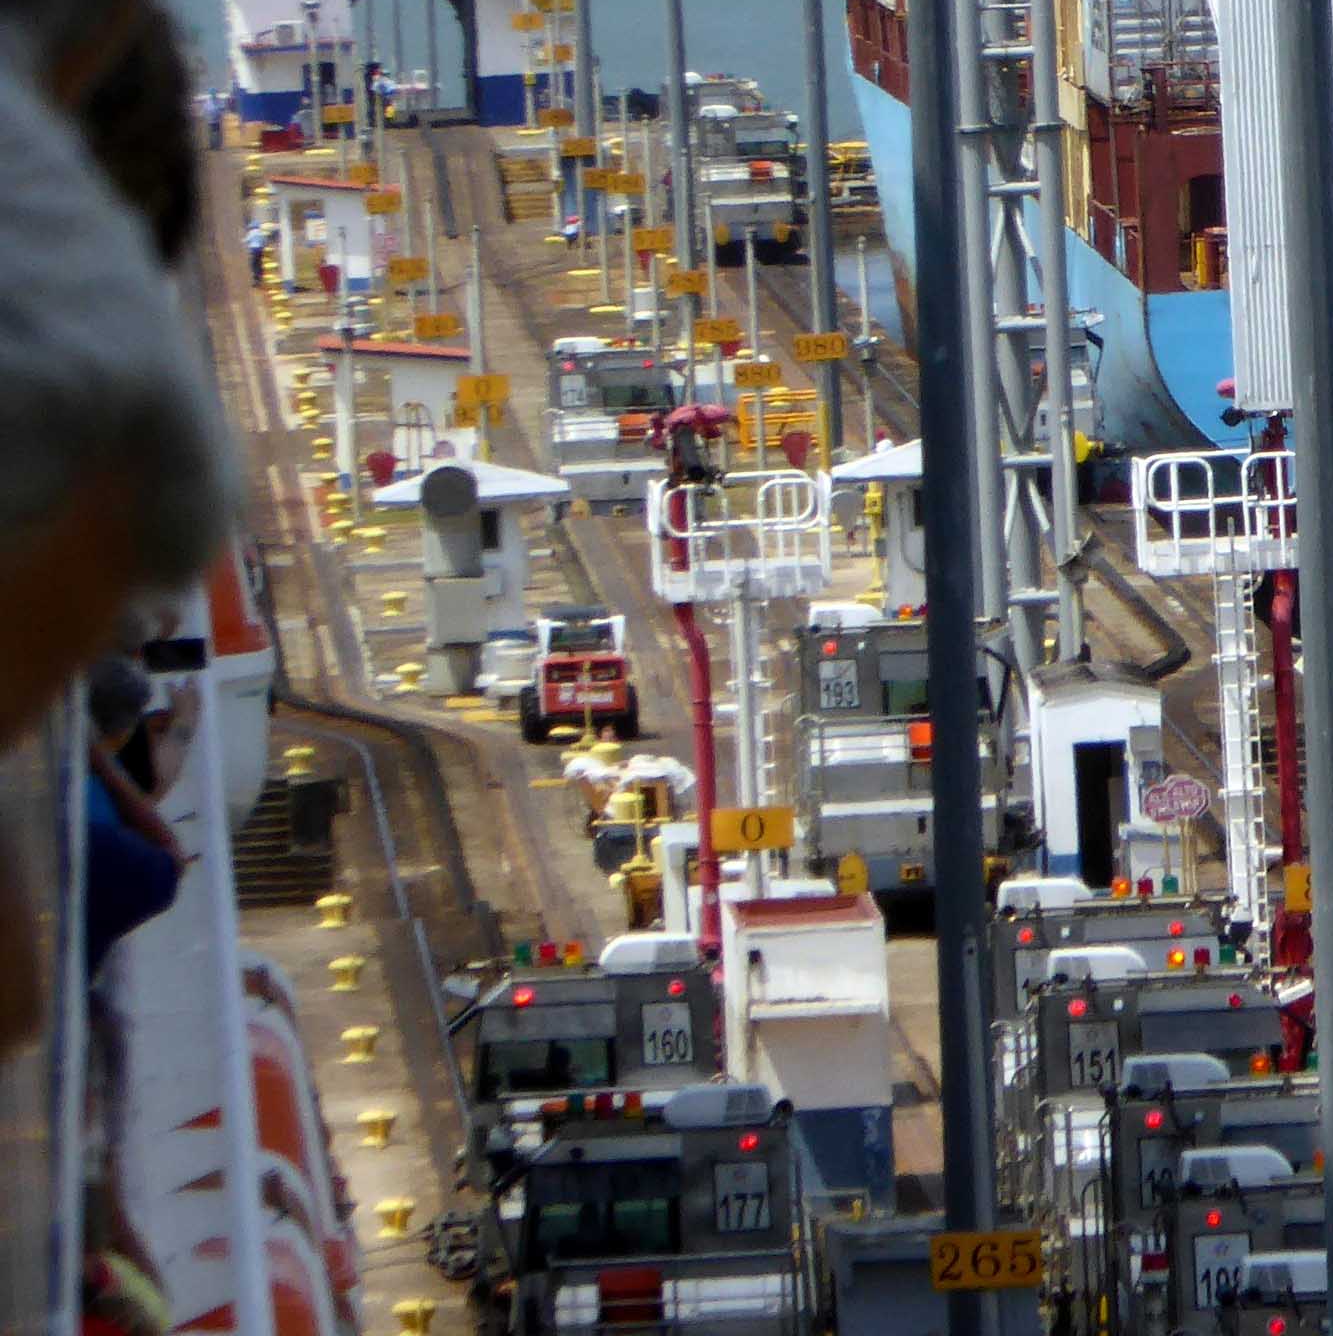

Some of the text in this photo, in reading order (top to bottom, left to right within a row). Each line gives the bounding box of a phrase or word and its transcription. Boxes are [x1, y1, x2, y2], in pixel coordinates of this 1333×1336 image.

[649, 1029, 689, 1060] 160
[1075, 1048, 1115, 1083] 151
[720, 1193, 765, 1230] 177
[939, 1239, 1038, 1281] 265
